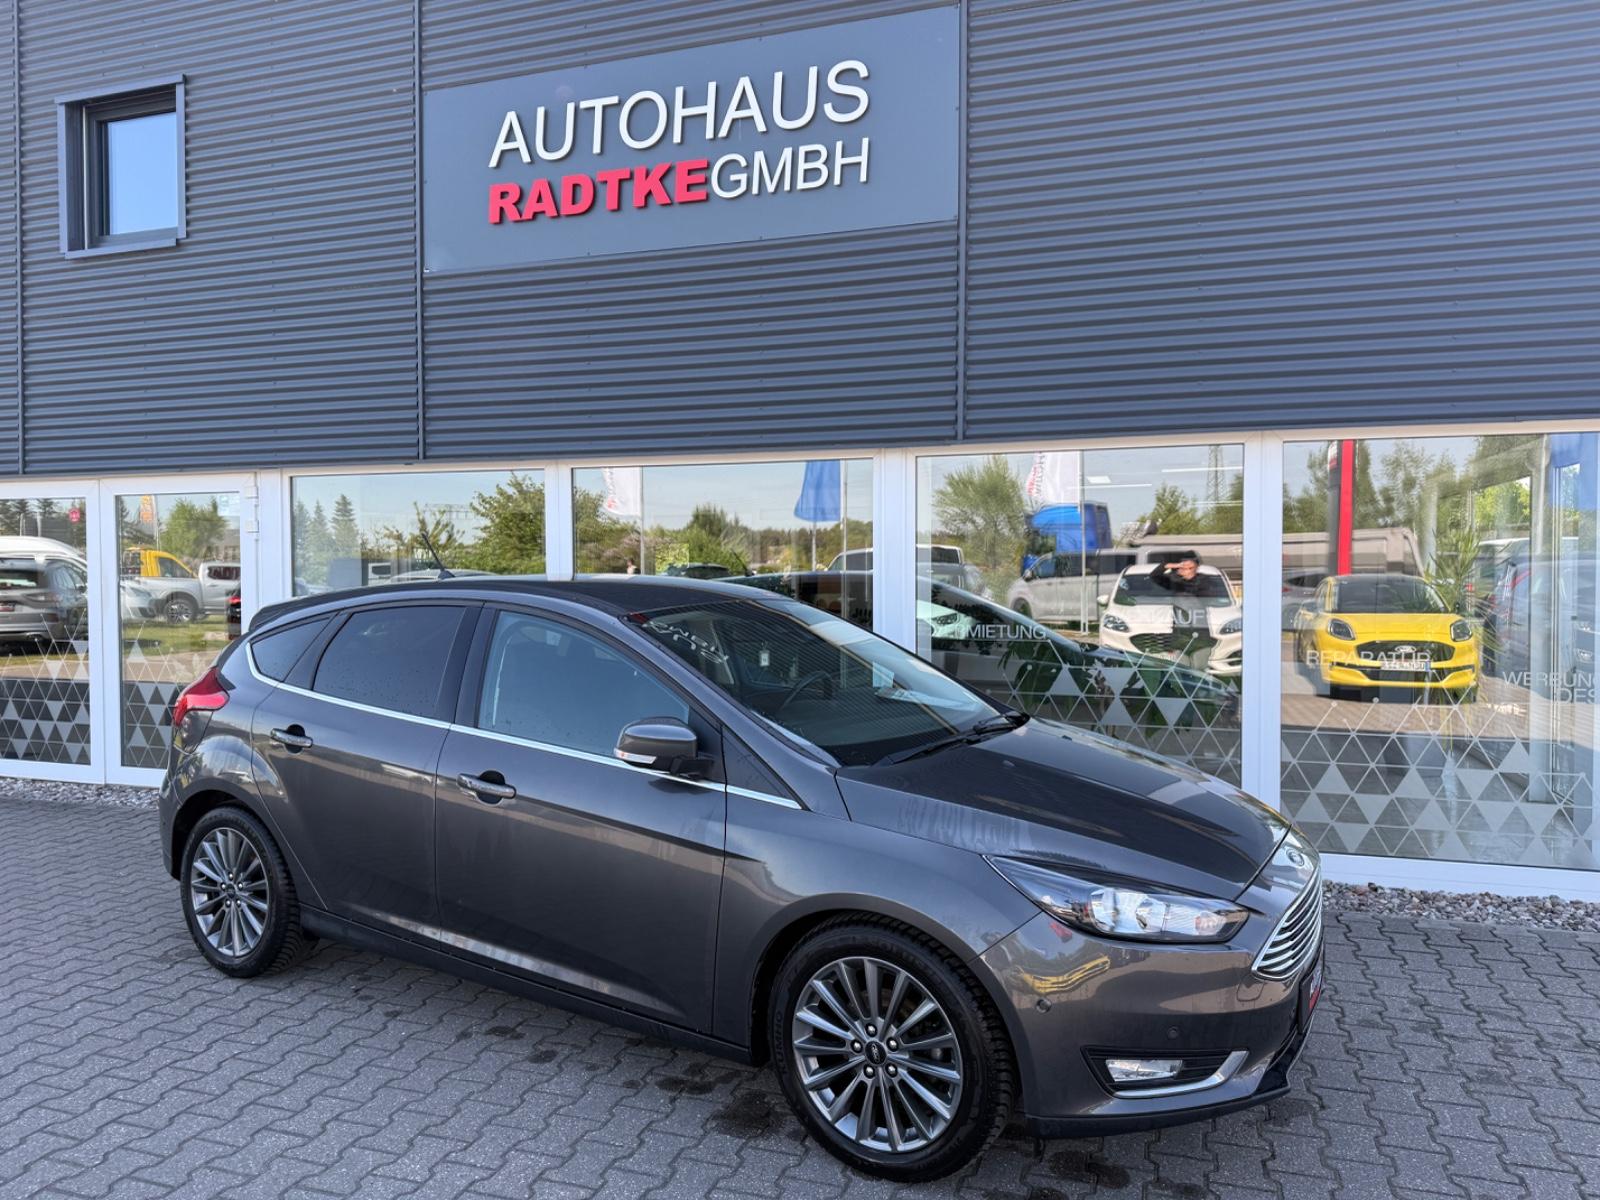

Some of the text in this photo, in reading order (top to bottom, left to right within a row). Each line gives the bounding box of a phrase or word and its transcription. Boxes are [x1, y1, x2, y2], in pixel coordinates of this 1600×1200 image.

[488, 60, 869, 168] AUTOHAUS
[488, 137, 869, 224] RADTKE GMBH
[1502, 671, 1596, 688] WERBUN
